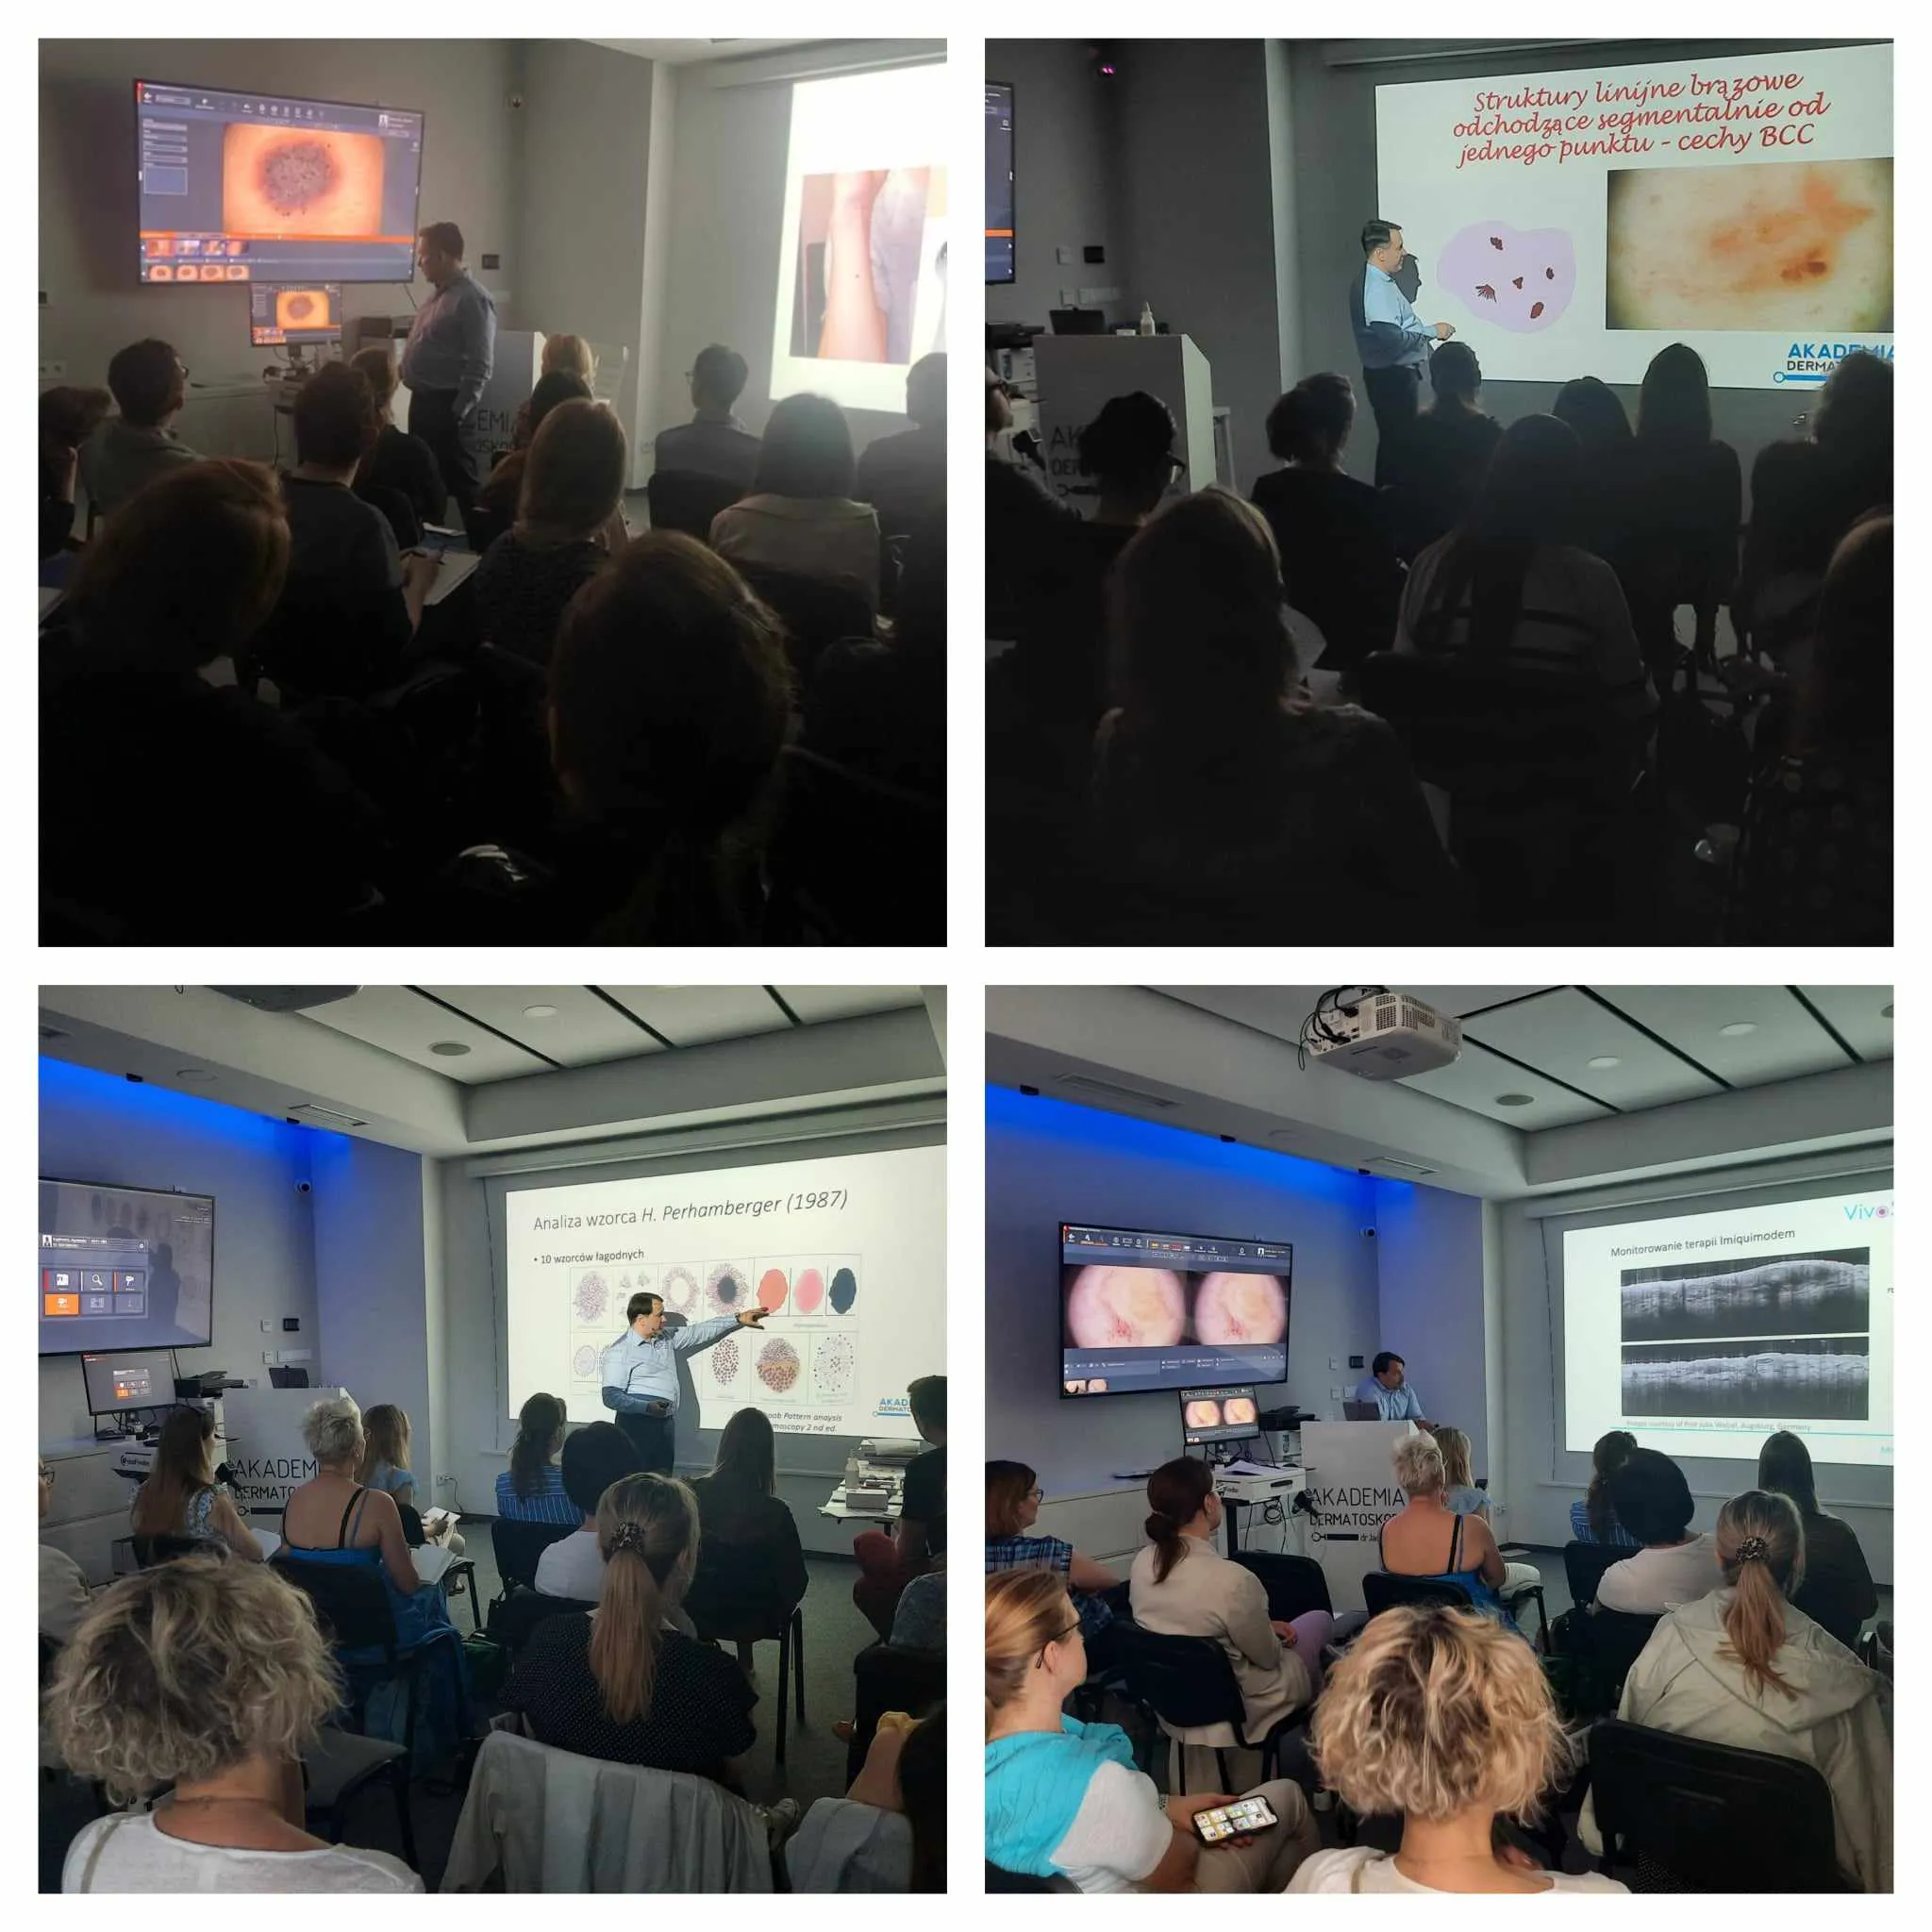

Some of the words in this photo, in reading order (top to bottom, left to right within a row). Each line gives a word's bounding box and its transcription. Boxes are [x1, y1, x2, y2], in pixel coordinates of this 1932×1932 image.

[1474, 87, 1589, 112] Struktury
[1595, 78, 1687, 108] linijne
[1690, 73, 1805, 101] brązowe
[1453, 111, 1594, 139] odchodzące
[1597, 97, 1785, 134] segmentalnie
[1788, 92, 1832, 117] od
[1456, 140, 1557, 169] jednego
[1559, 133, 1655, 163] punktu
[1678, 126, 1753, 154] cechy
[1759, 123, 1815, 147] BCC
[533, 1214, 582, 1230] Analiza
[586, 1211, 637, 1226] wzorca
[641, 1207, 657, 1223] H.
[662, 1199, 782, 1221] Perhamberger
[787, 1189, 848, 1214] (1987)
[541, 1255, 552, 1264] 10
[554, 1252, 593, 1264] wzorców
[595, 1248, 644, 1263] łagodnych
[1610, 1241, 1683, 1257] Monitorowanie
[1685, 1237, 1717, 1250] terapii
[1720, 1229, 1796, 1246] Imiquimodem
[1311, 1488, 1406, 1507] AKADEMIA
